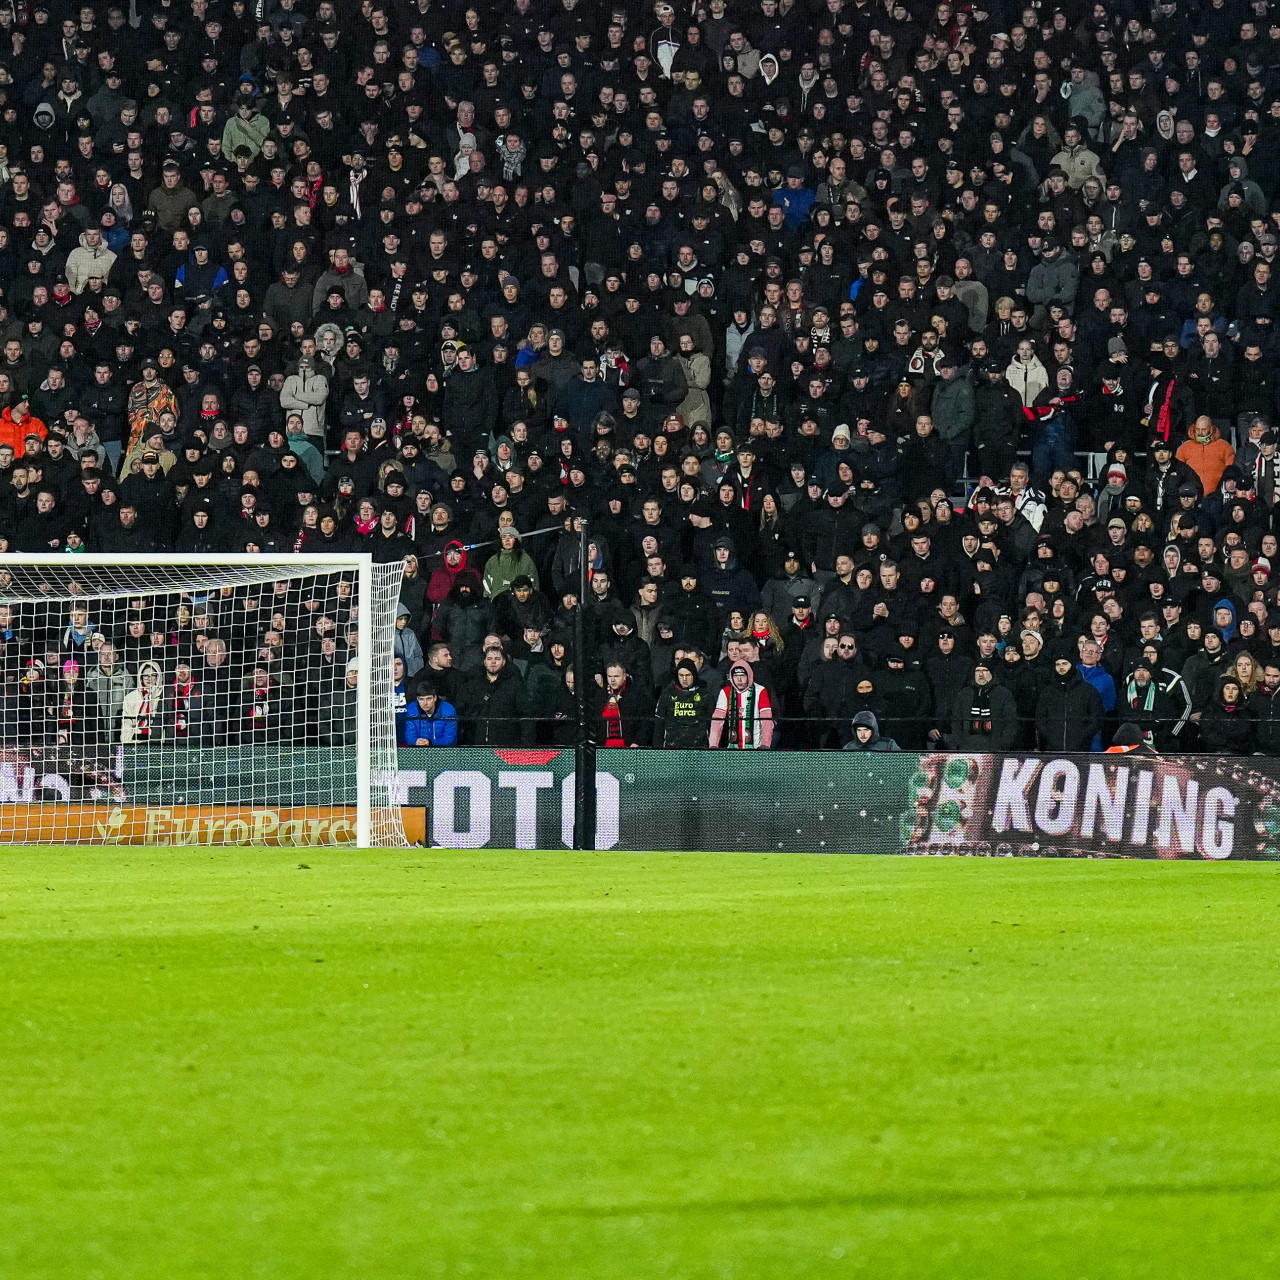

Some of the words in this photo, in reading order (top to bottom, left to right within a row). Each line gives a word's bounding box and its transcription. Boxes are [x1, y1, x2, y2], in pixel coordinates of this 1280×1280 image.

[674, 709, 696, 717] Parcs
[675, 701, 694, 709] Euro
[372, 769, 620, 850] TOTO
[991, 758, 1238, 859] KONING
